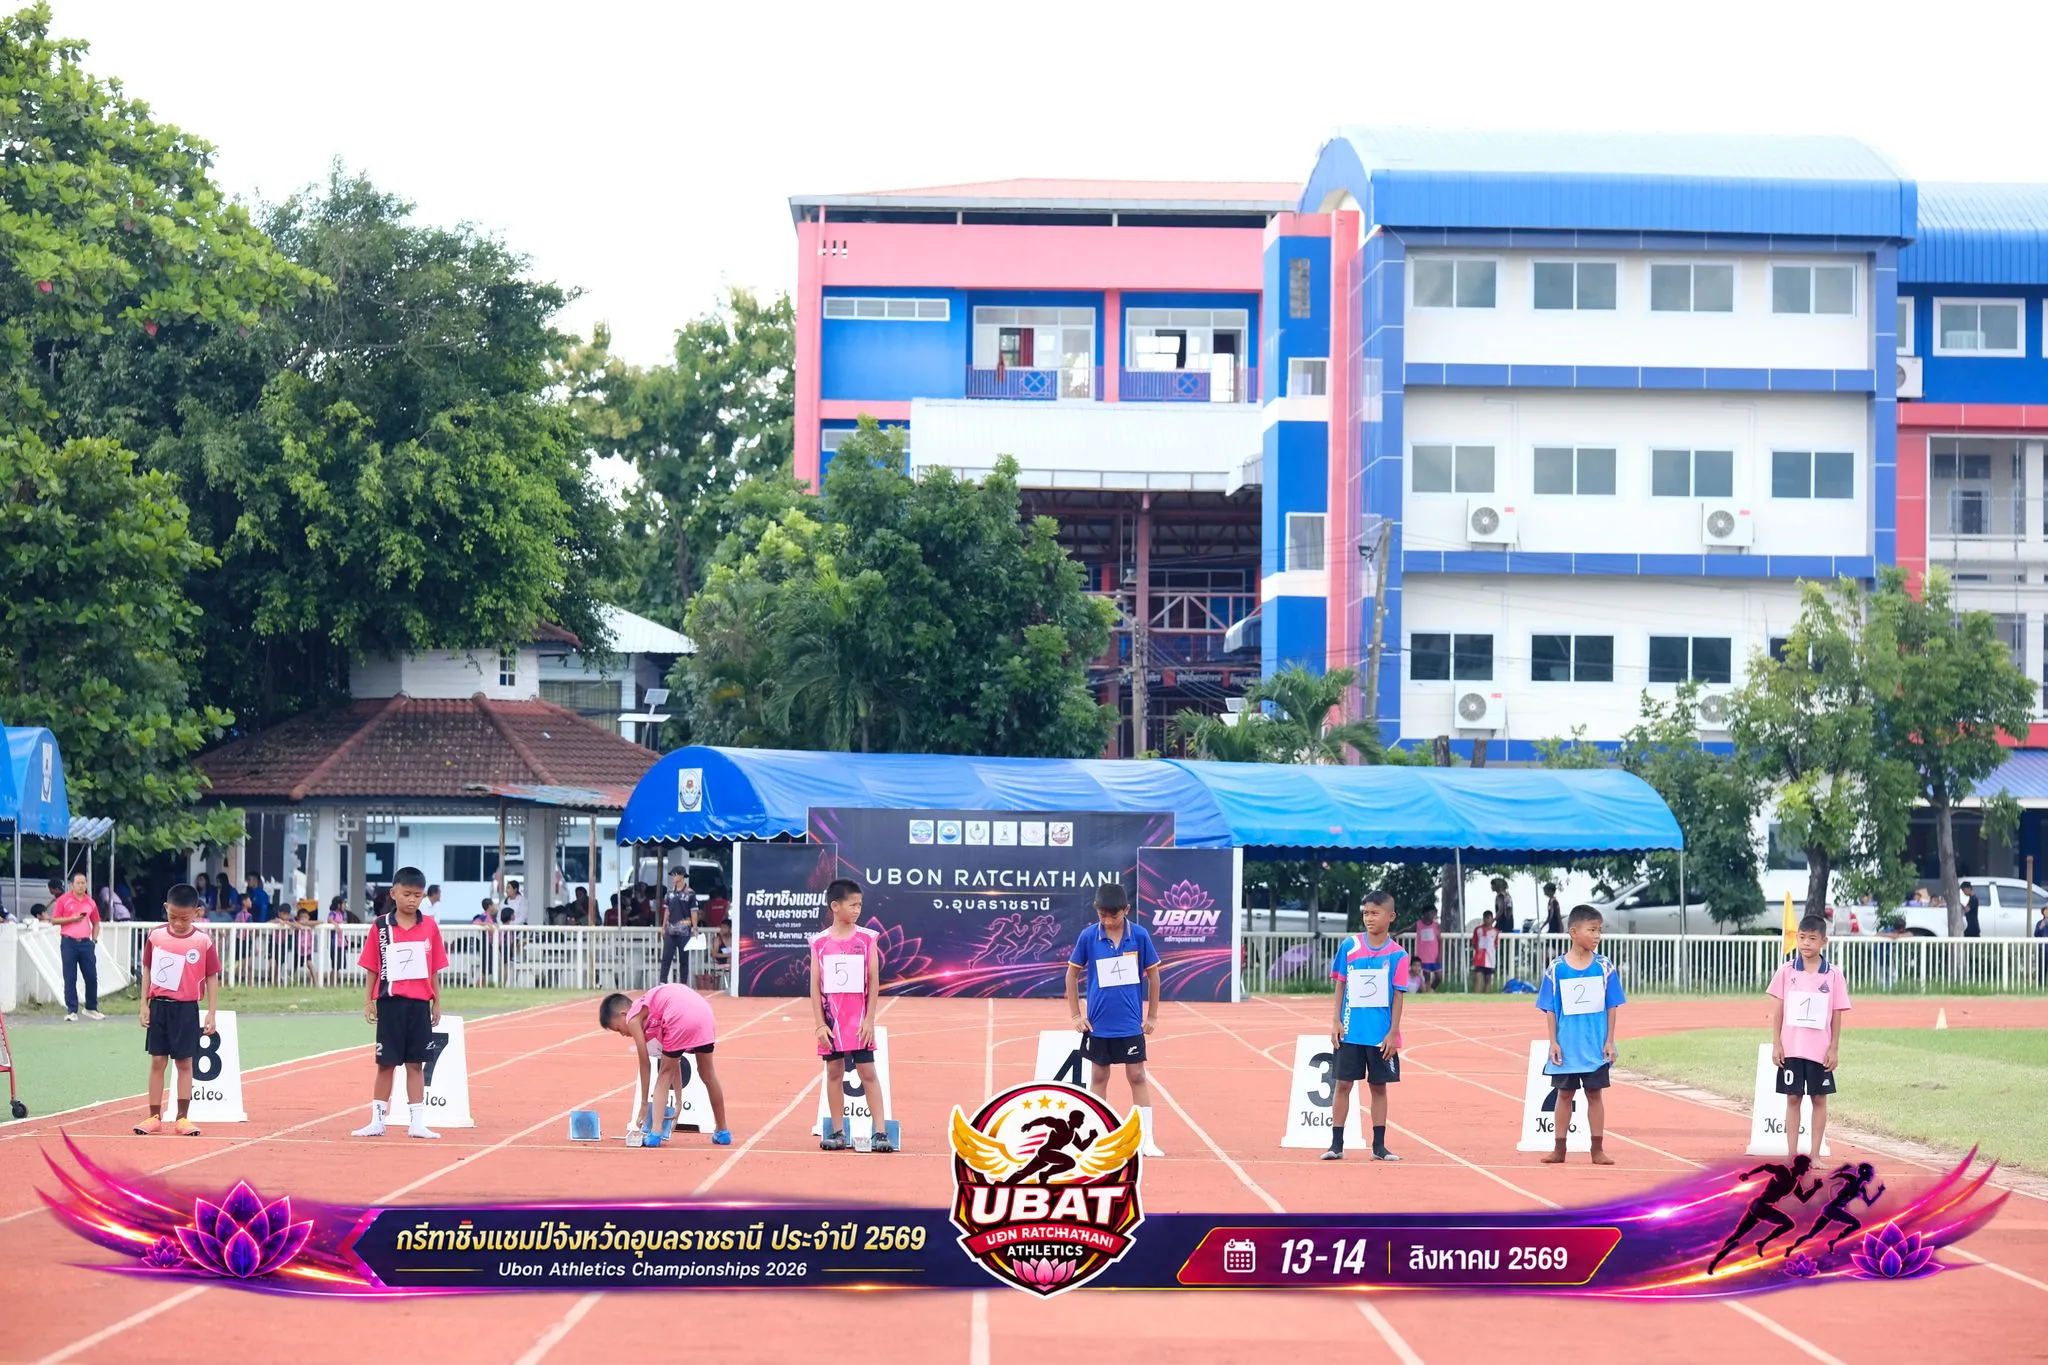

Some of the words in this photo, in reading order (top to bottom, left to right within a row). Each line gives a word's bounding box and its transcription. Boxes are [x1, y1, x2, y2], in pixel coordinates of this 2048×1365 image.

[866, 868, 942, 885] UBON
[955, 869, 1120, 888] RATCHATHANI
[756, 907, 819, 922] จ.อุบลราชธานี
[933, 897, 1050, 914] จ.อุบลราชธานี
[1152, 910, 1222, 926] UBON
[1152, 926, 1218, 936] ATHLETICS
[156, 956, 175, 983] 8
[396, 948, 414, 973] 7
[1110, 960, 1128, 980] 4
[834, 961, 849, 987] 5
[1359, 974, 1378, 998] 3
[1573, 984, 1591, 1004] 2
[1796, 996, 1817, 1021] 1
[191, 1027, 222, 1081] 8
[1053, 1049, 1087, 1089] 4
[1307, 1052, 1336, 1107] 3
[191, 1086, 223, 1101] elco
[425, 1092, 447, 1107] lco
[843, 1102, 872, 1117] elco
[1301, 1111, 1333, 1127] Nelc
[1535, 1117, 1577, 1133] Neo
